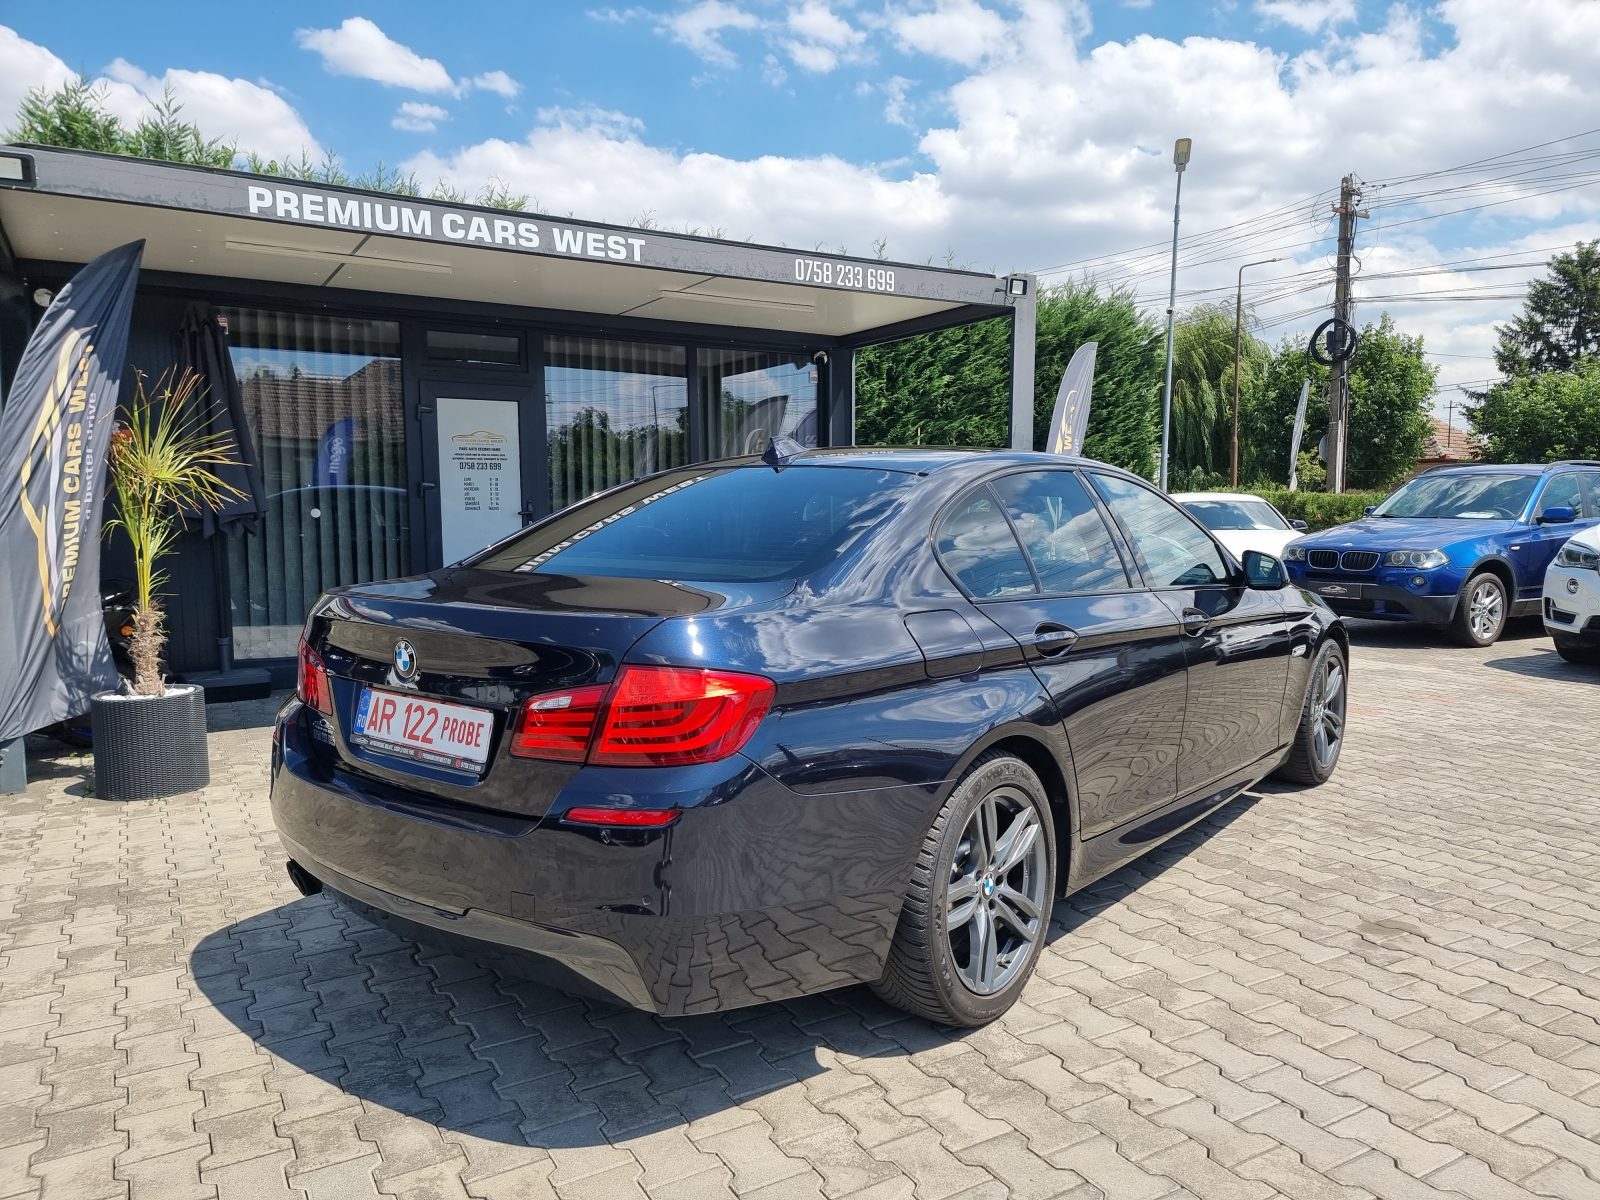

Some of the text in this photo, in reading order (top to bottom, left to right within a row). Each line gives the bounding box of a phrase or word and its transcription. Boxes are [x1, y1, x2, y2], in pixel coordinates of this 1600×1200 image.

[248, 186, 646, 262] PREMIUM CARS WEST
[795, 258, 895, 292] 0758 233 699
[63, 422, 82, 494] CARS
[83, 448, 93, 504] better
[460, 462, 502, 471] 0758 233 699
[61, 500, 81, 611] REMIUM
[356, 714, 367, 728] RO
[366, 697, 397, 735] AR
[402, 703, 439, 745] 122
[440, 716, 485, 748] PROBE
